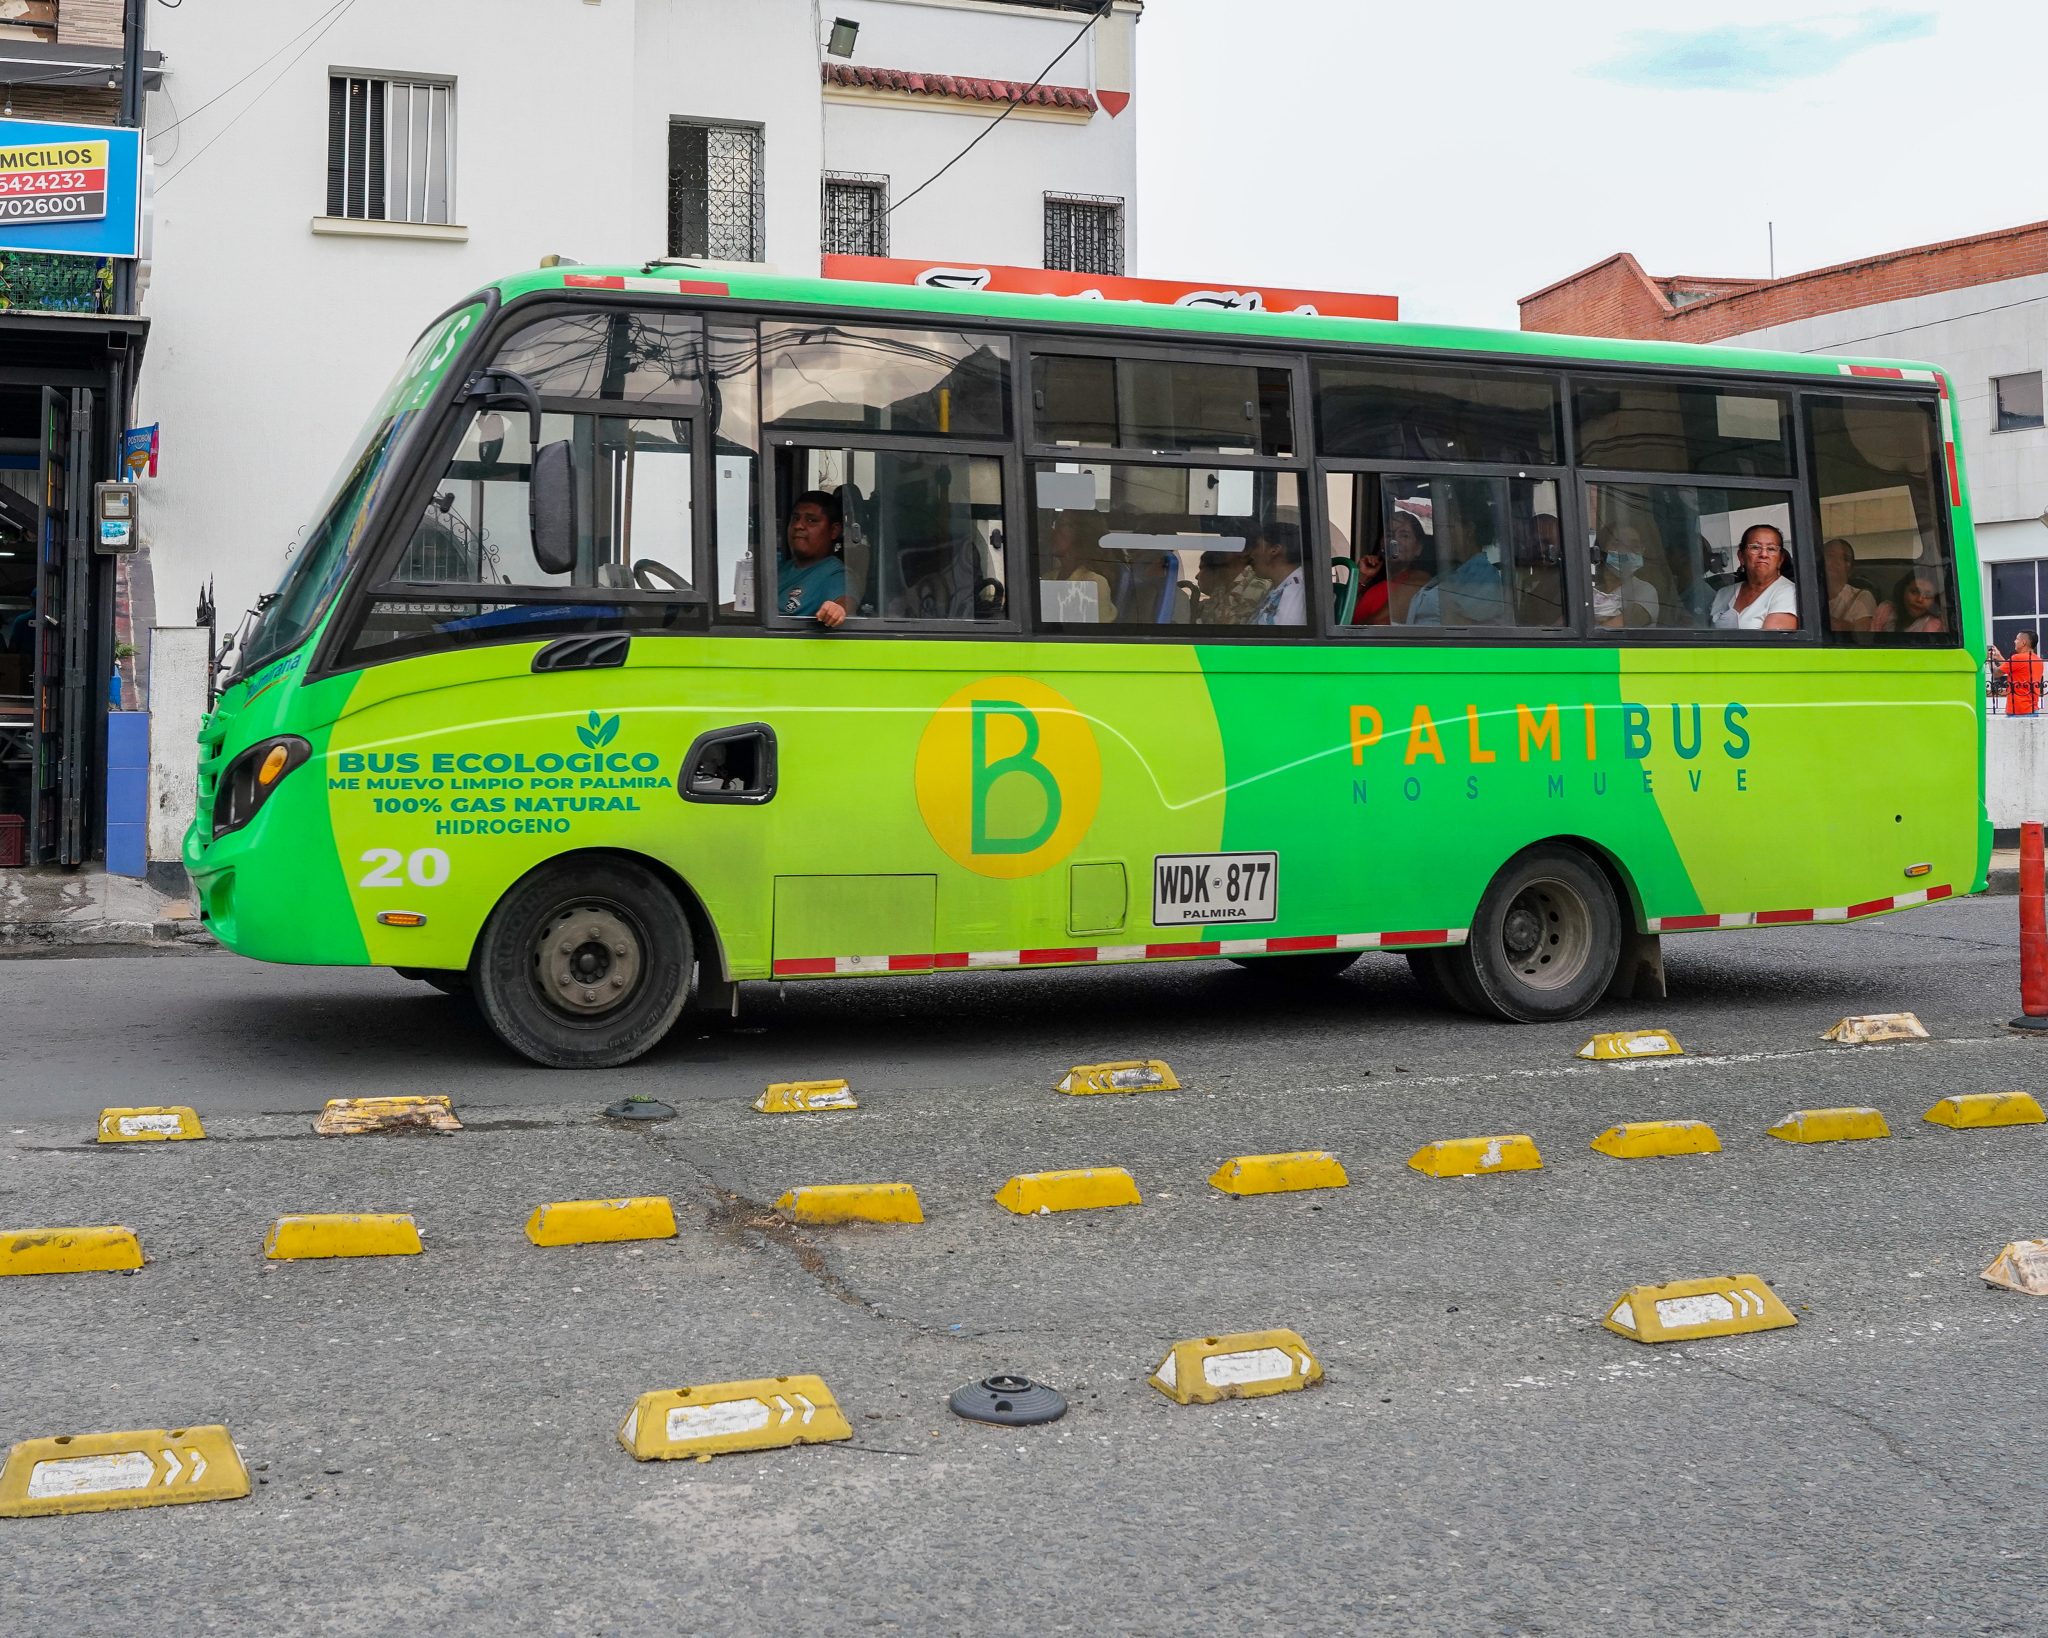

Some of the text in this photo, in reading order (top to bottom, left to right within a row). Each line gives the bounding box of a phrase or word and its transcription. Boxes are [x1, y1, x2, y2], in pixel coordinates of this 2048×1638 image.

[0, 149, 92, 168] MICILIOS
[0, 173, 86, 192] 5424232
[0, 196, 86, 216] 7026001
[1349, 702, 1750, 766] PALMIBUS
[339, 752, 659, 773] BUS ECOLOGICO
[328, 776, 672, 790] ME MUEVO LIMPIO POR PALMIRA
[971, 700, 1062, 854] B
[1352, 769, 1747, 805] NOS MUEVE
[373, 796, 640, 813] 100% GAS NATURAL
[435, 818, 570, 834] HIDROGENO
[359, 848, 450, 887] 20
[1159, 863, 1271, 904] WDK 877
[1183, 908, 1247, 918] PALMIRA
